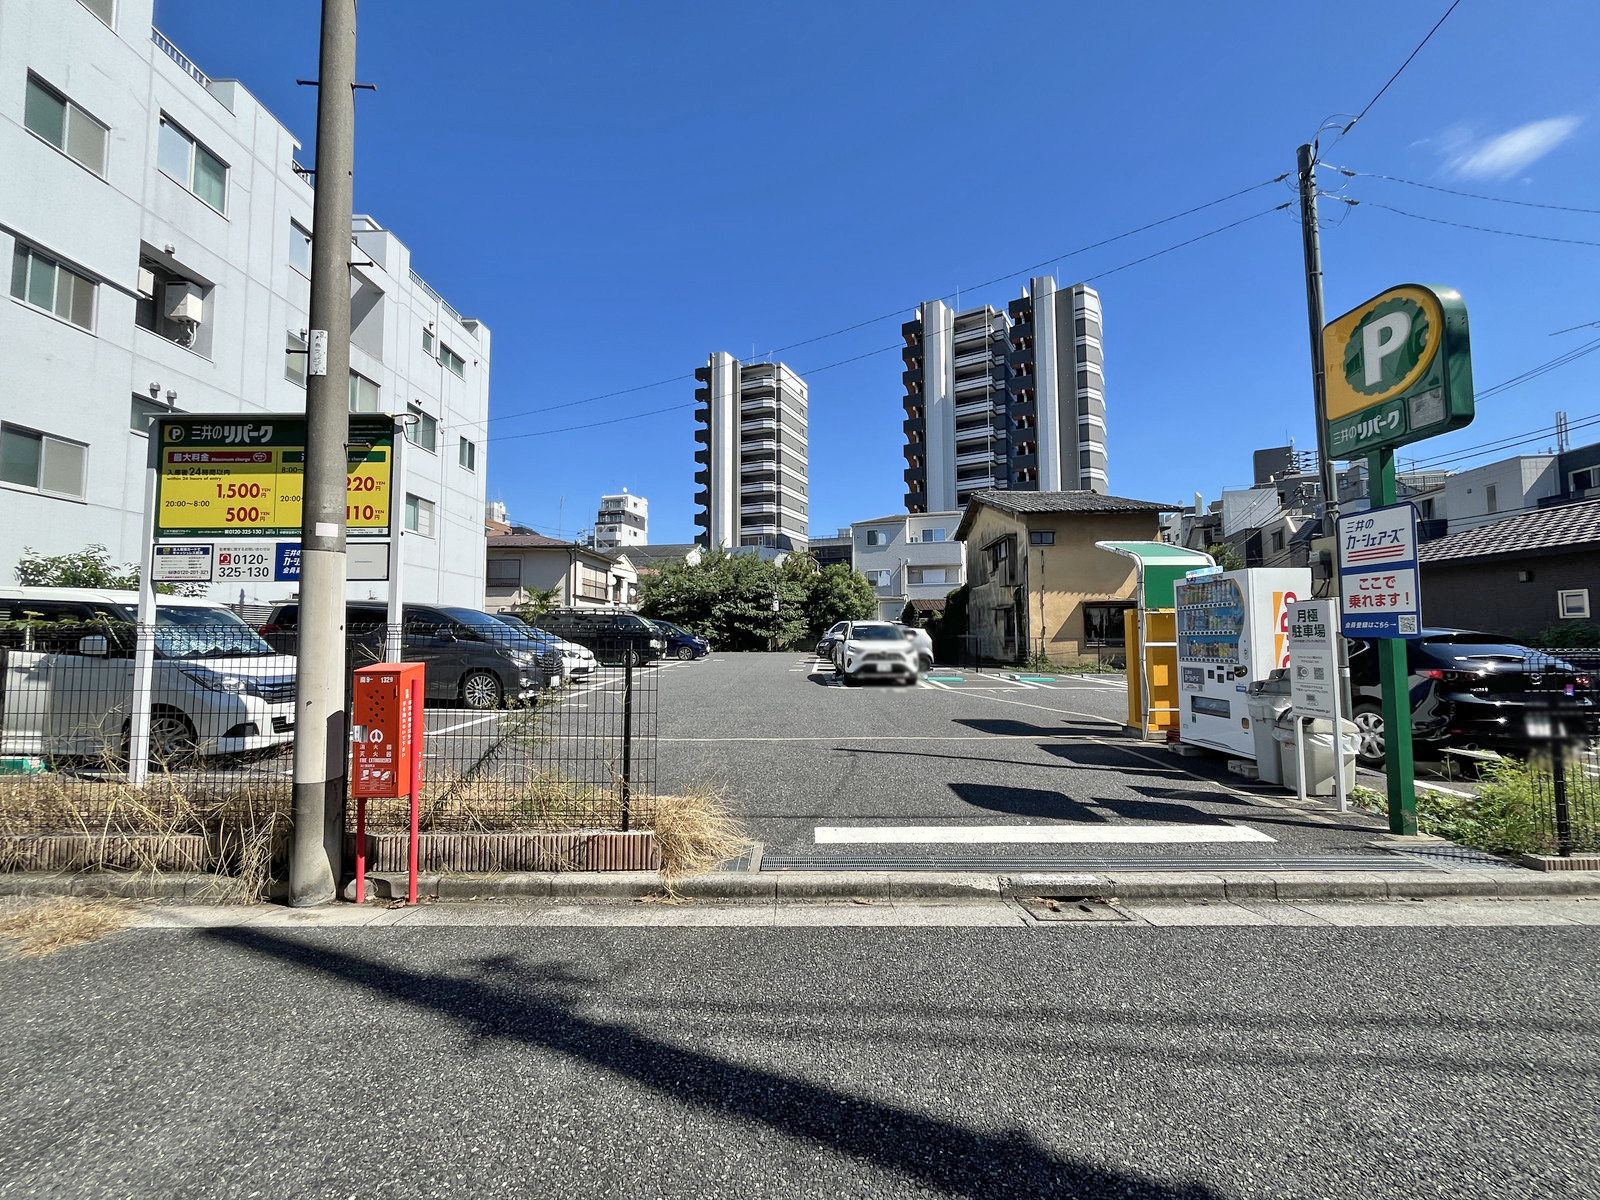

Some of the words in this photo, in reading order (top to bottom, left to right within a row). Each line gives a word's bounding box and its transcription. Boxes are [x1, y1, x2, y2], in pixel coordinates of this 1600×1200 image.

[1363, 311, 1412, 387] P
[172, 428, 181, 440] P
[191, 424, 274, 443] 三井のリパーク
[1333, 409, 1400, 446] 三井のリパーク
[173, 453, 209, 462] 最大料金
[217, 483, 260, 498] 1,500
[225, 507, 259, 522] 500
[1345, 518, 1374, 534] 三井の
[1346, 528, 1405, 550] カーシェアーズ
[233, 554, 268, 564] 0120-
[218, 567, 269, 577] 325-130
[1359, 575, 1396, 591] ここで
[1297, 609, 1319, 623] 月極
[1292, 624, 1326, 638] 駐車場
[1345, 621, 1389, 629] 会員登録はこちら
